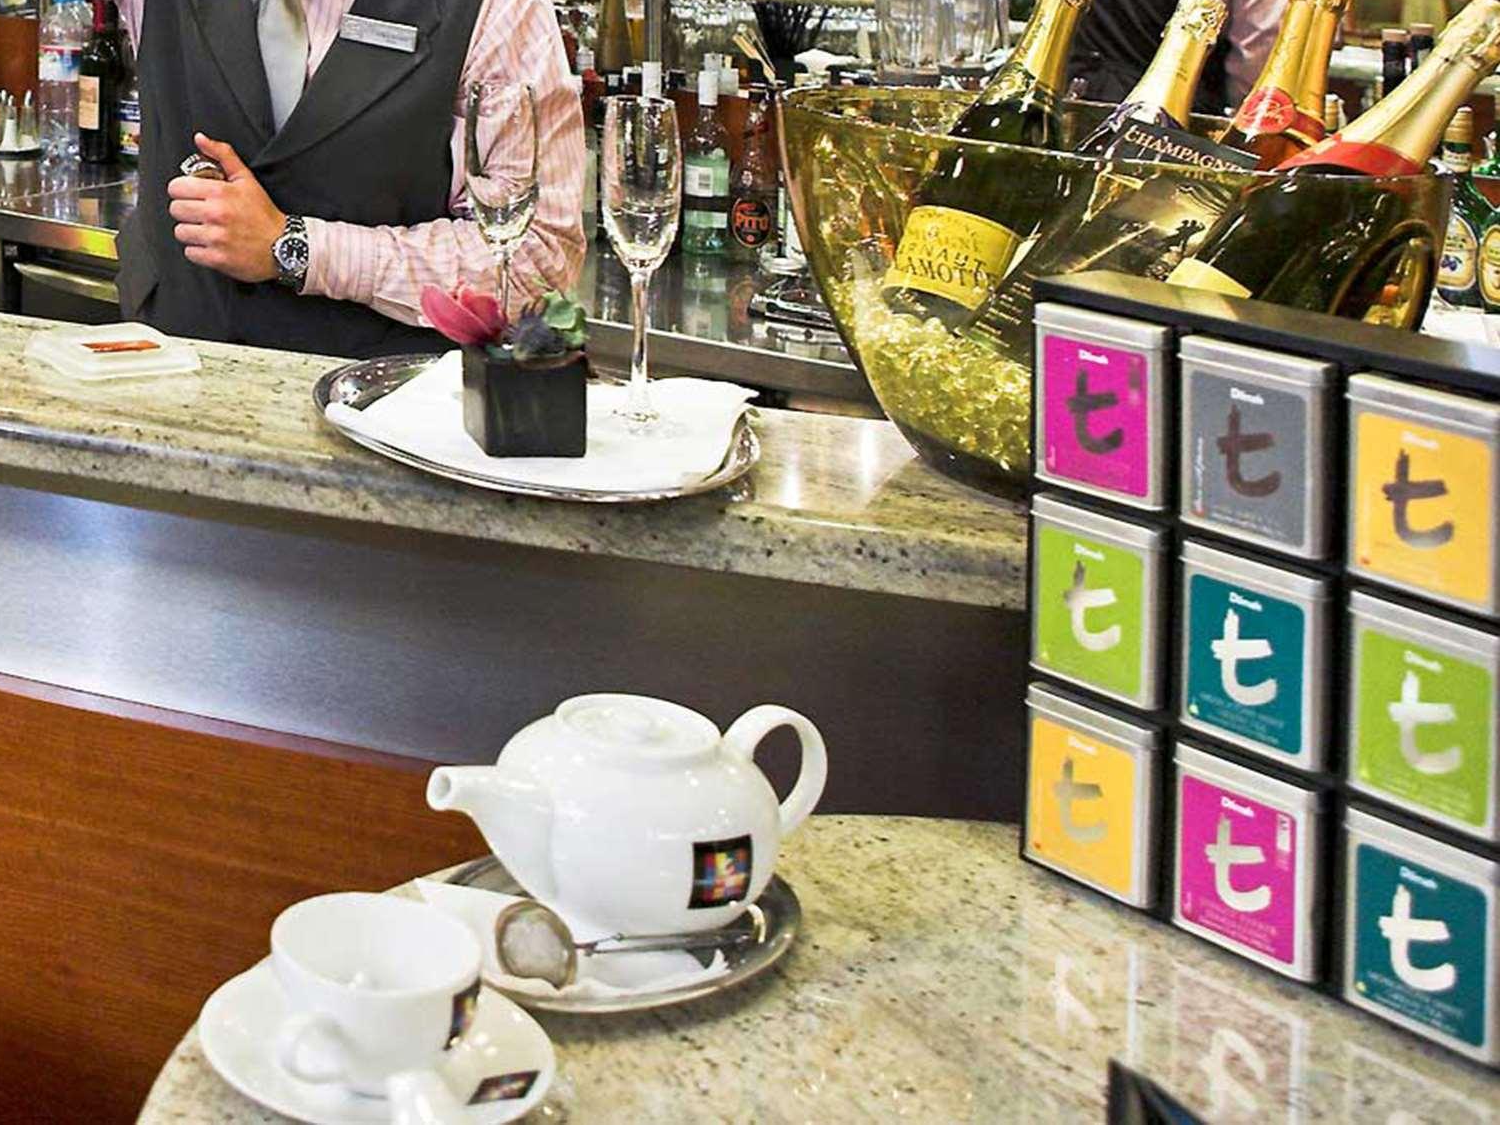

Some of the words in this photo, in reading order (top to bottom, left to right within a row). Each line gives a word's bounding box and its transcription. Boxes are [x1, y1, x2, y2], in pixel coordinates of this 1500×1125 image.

[1067, 369, 1124, 455] t
[1216, 404, 1282, 498] t
[1381, 447, 1455, 549] t
[1063, 560, 1122, 652] t
[1211, 607, 1278, 706] t
[1386, 669, 1463, 775] t
[1053, 755, 1109, 844] t
[1204, 812, 1272, 913] t
[1378, 883, 1457, 992] t
